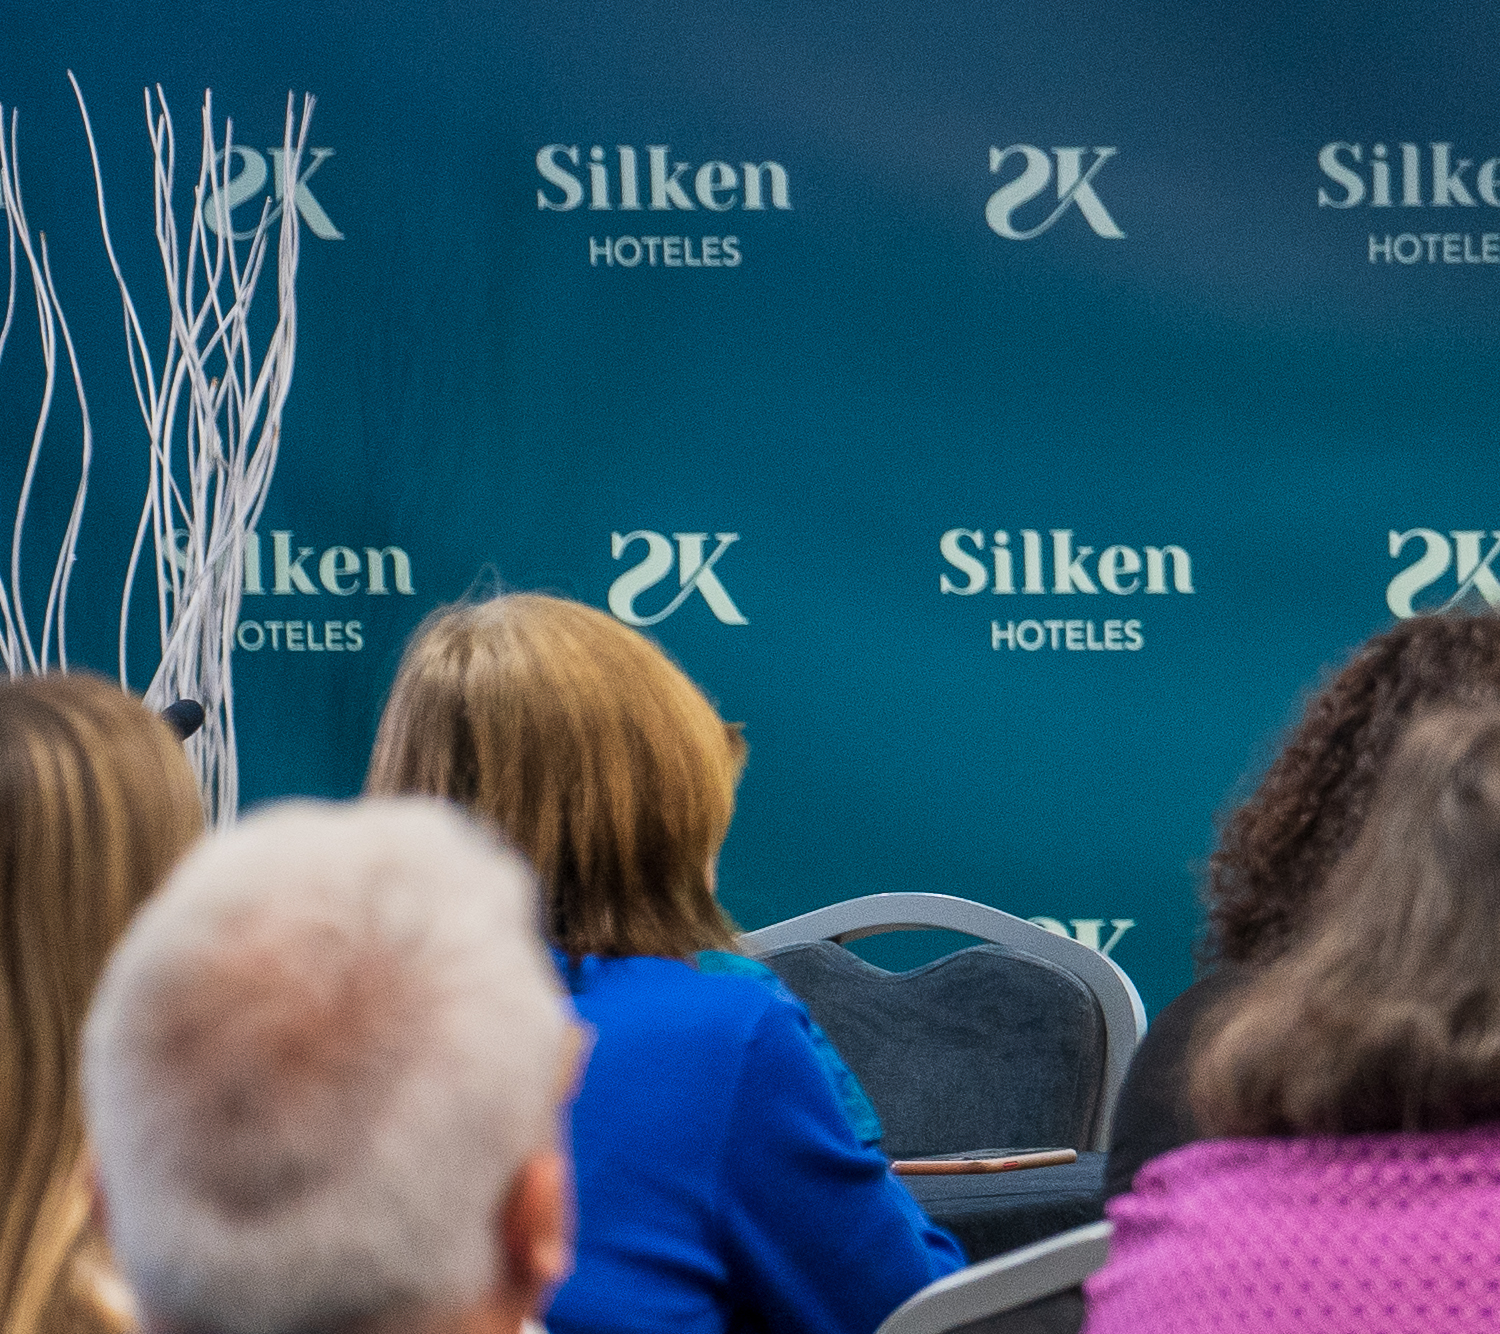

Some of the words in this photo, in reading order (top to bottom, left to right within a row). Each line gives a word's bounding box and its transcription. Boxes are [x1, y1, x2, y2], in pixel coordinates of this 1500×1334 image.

[536, 145, 791, 211] Silken
[589, 235, 742, 268] HOTELES
[162, 528, 416, 599] lken
[940, 528, 1193, 595] Silken
[224, 620, 364, 654] OTELES
[991, 619, 1144, 652] HOTELES
